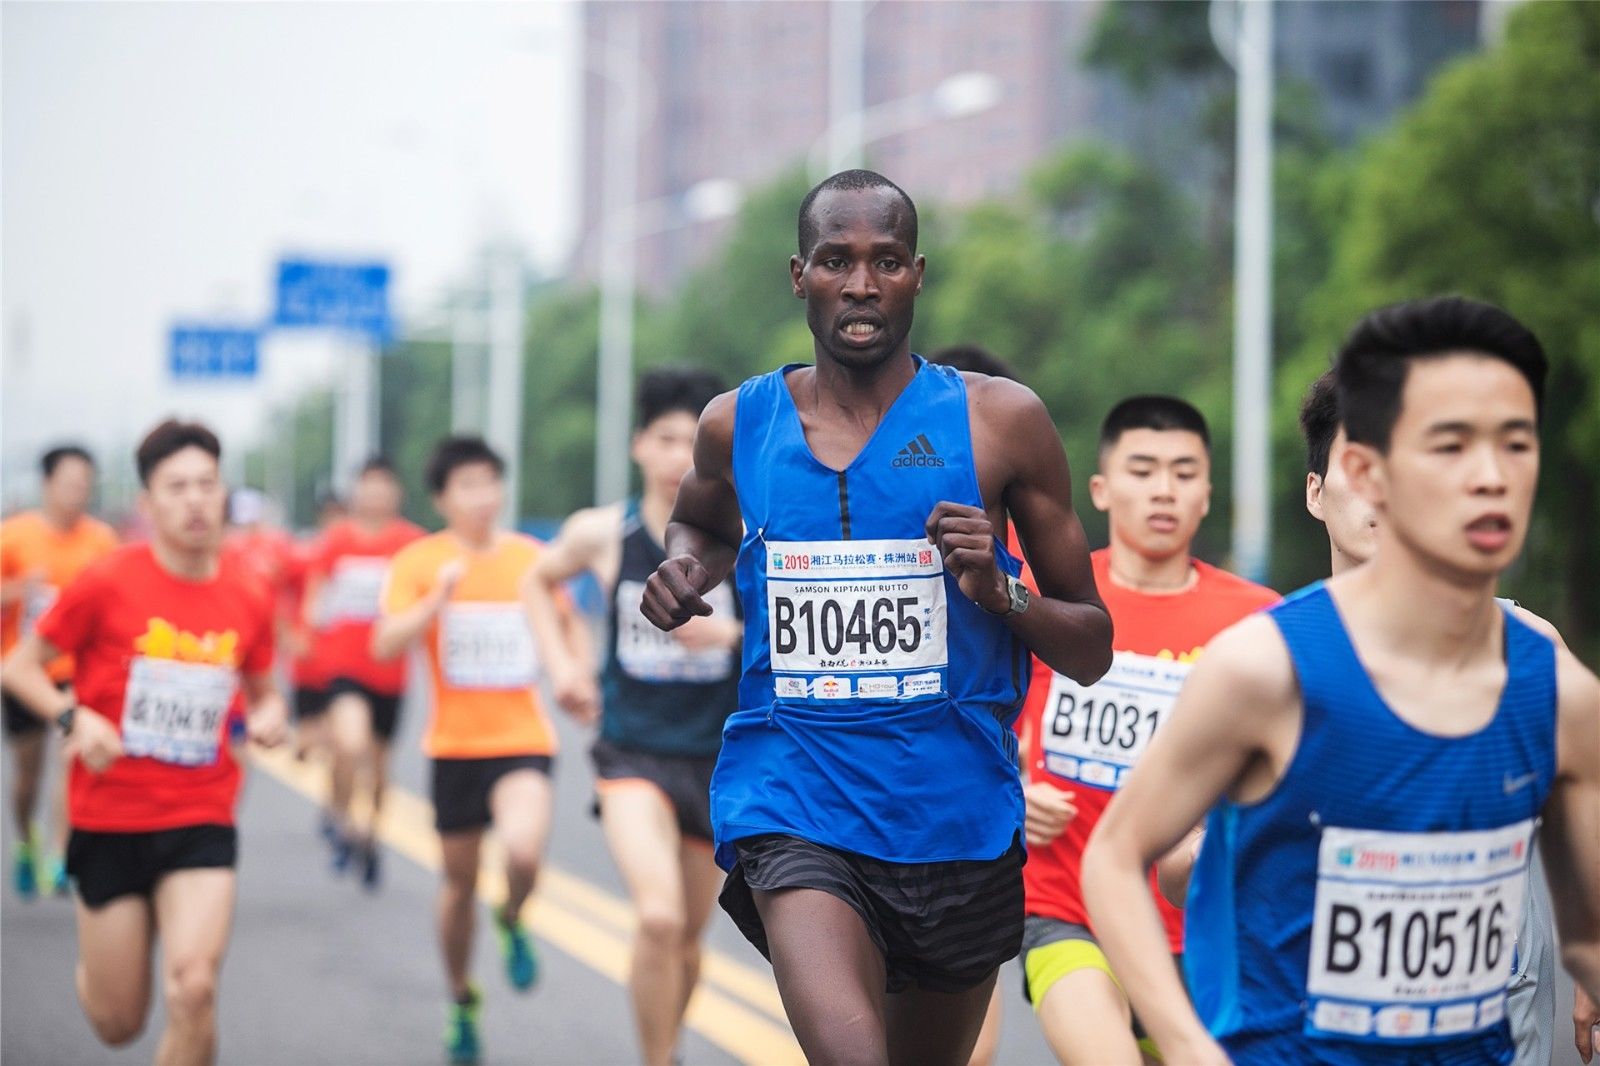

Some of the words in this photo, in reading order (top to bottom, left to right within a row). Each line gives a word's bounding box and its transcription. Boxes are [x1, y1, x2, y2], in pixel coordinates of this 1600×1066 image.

[892, 454, 945, 468] adidas
[784, 554, 810, 570] 2019
[795, 585, 830, 594] SAMSON
[833, 584, 876, 593] KIPTANUI
[878, 583, 909, 592] RUTTO
[775, 596, 922, 656] B10465
[1326, 900, 1505, 980] B10516
